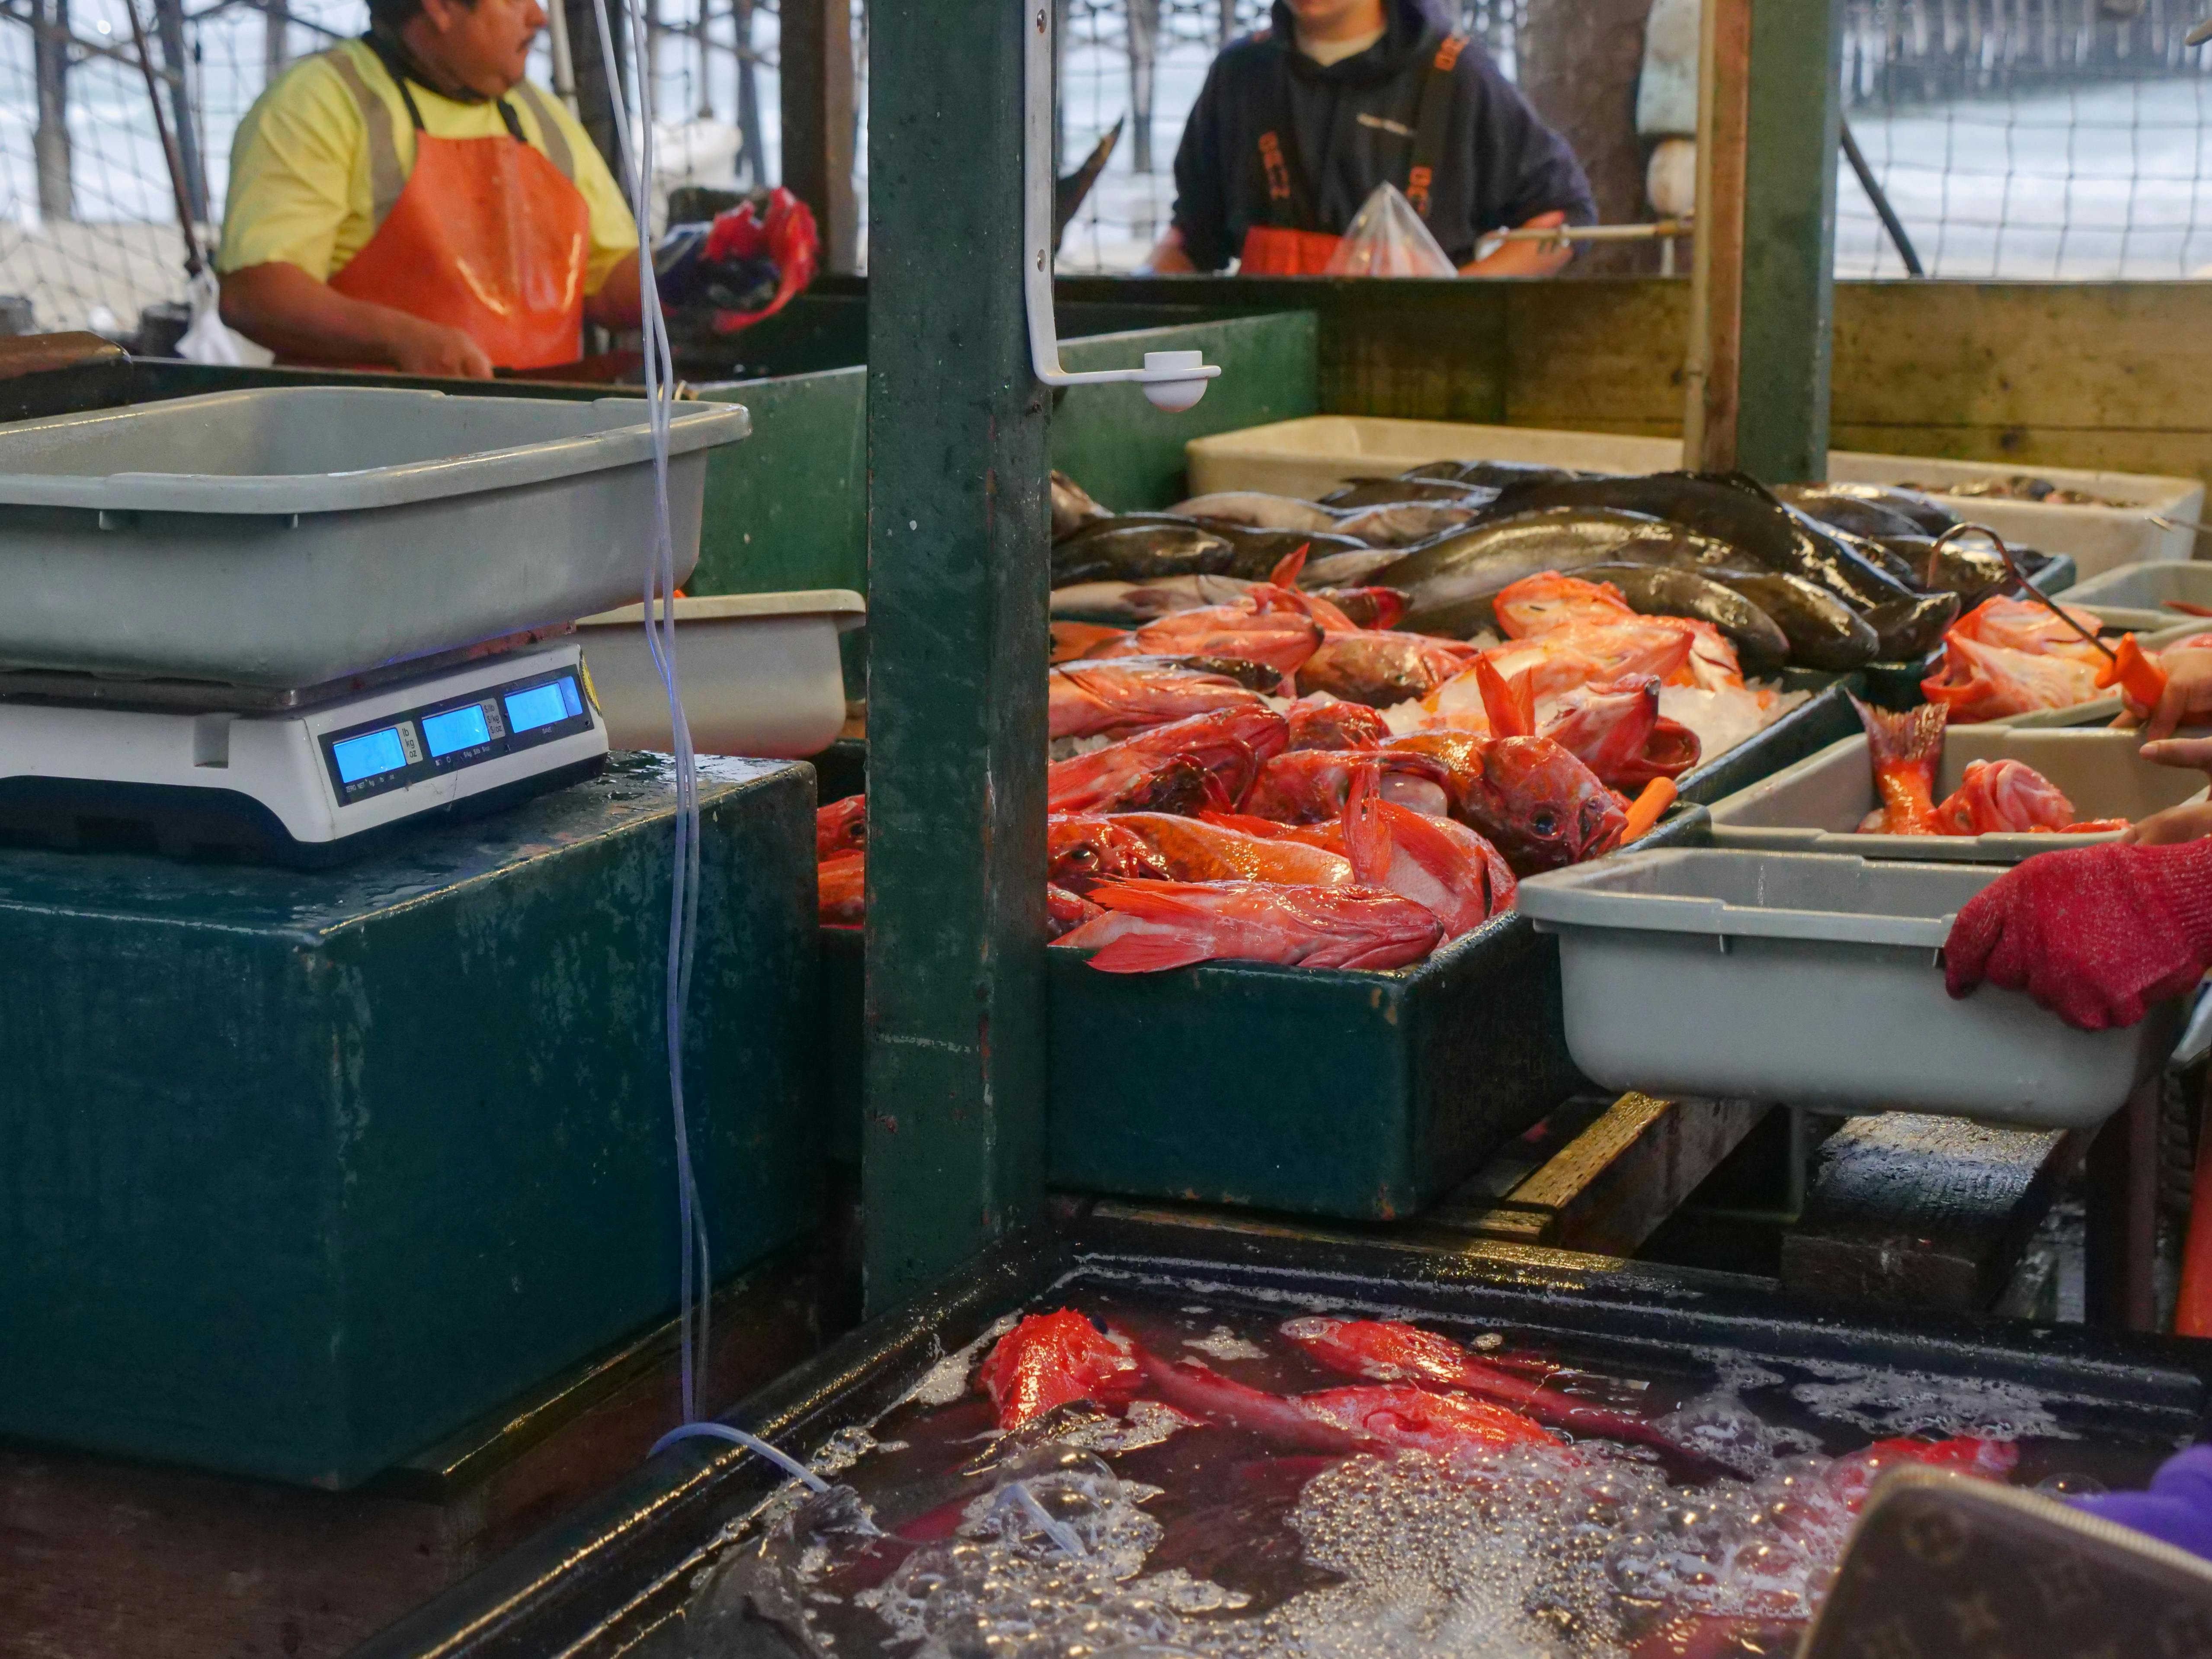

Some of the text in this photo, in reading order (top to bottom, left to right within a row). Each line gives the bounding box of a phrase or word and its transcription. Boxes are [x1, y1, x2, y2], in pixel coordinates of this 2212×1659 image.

[483, 704, 495, 713] $/lb
[487, 714, 500, 724] $/kg
[402, 728, 409, 737] lb
[490, 725, 503, 734] $/oz
[406, 739, 415, 749] kg
